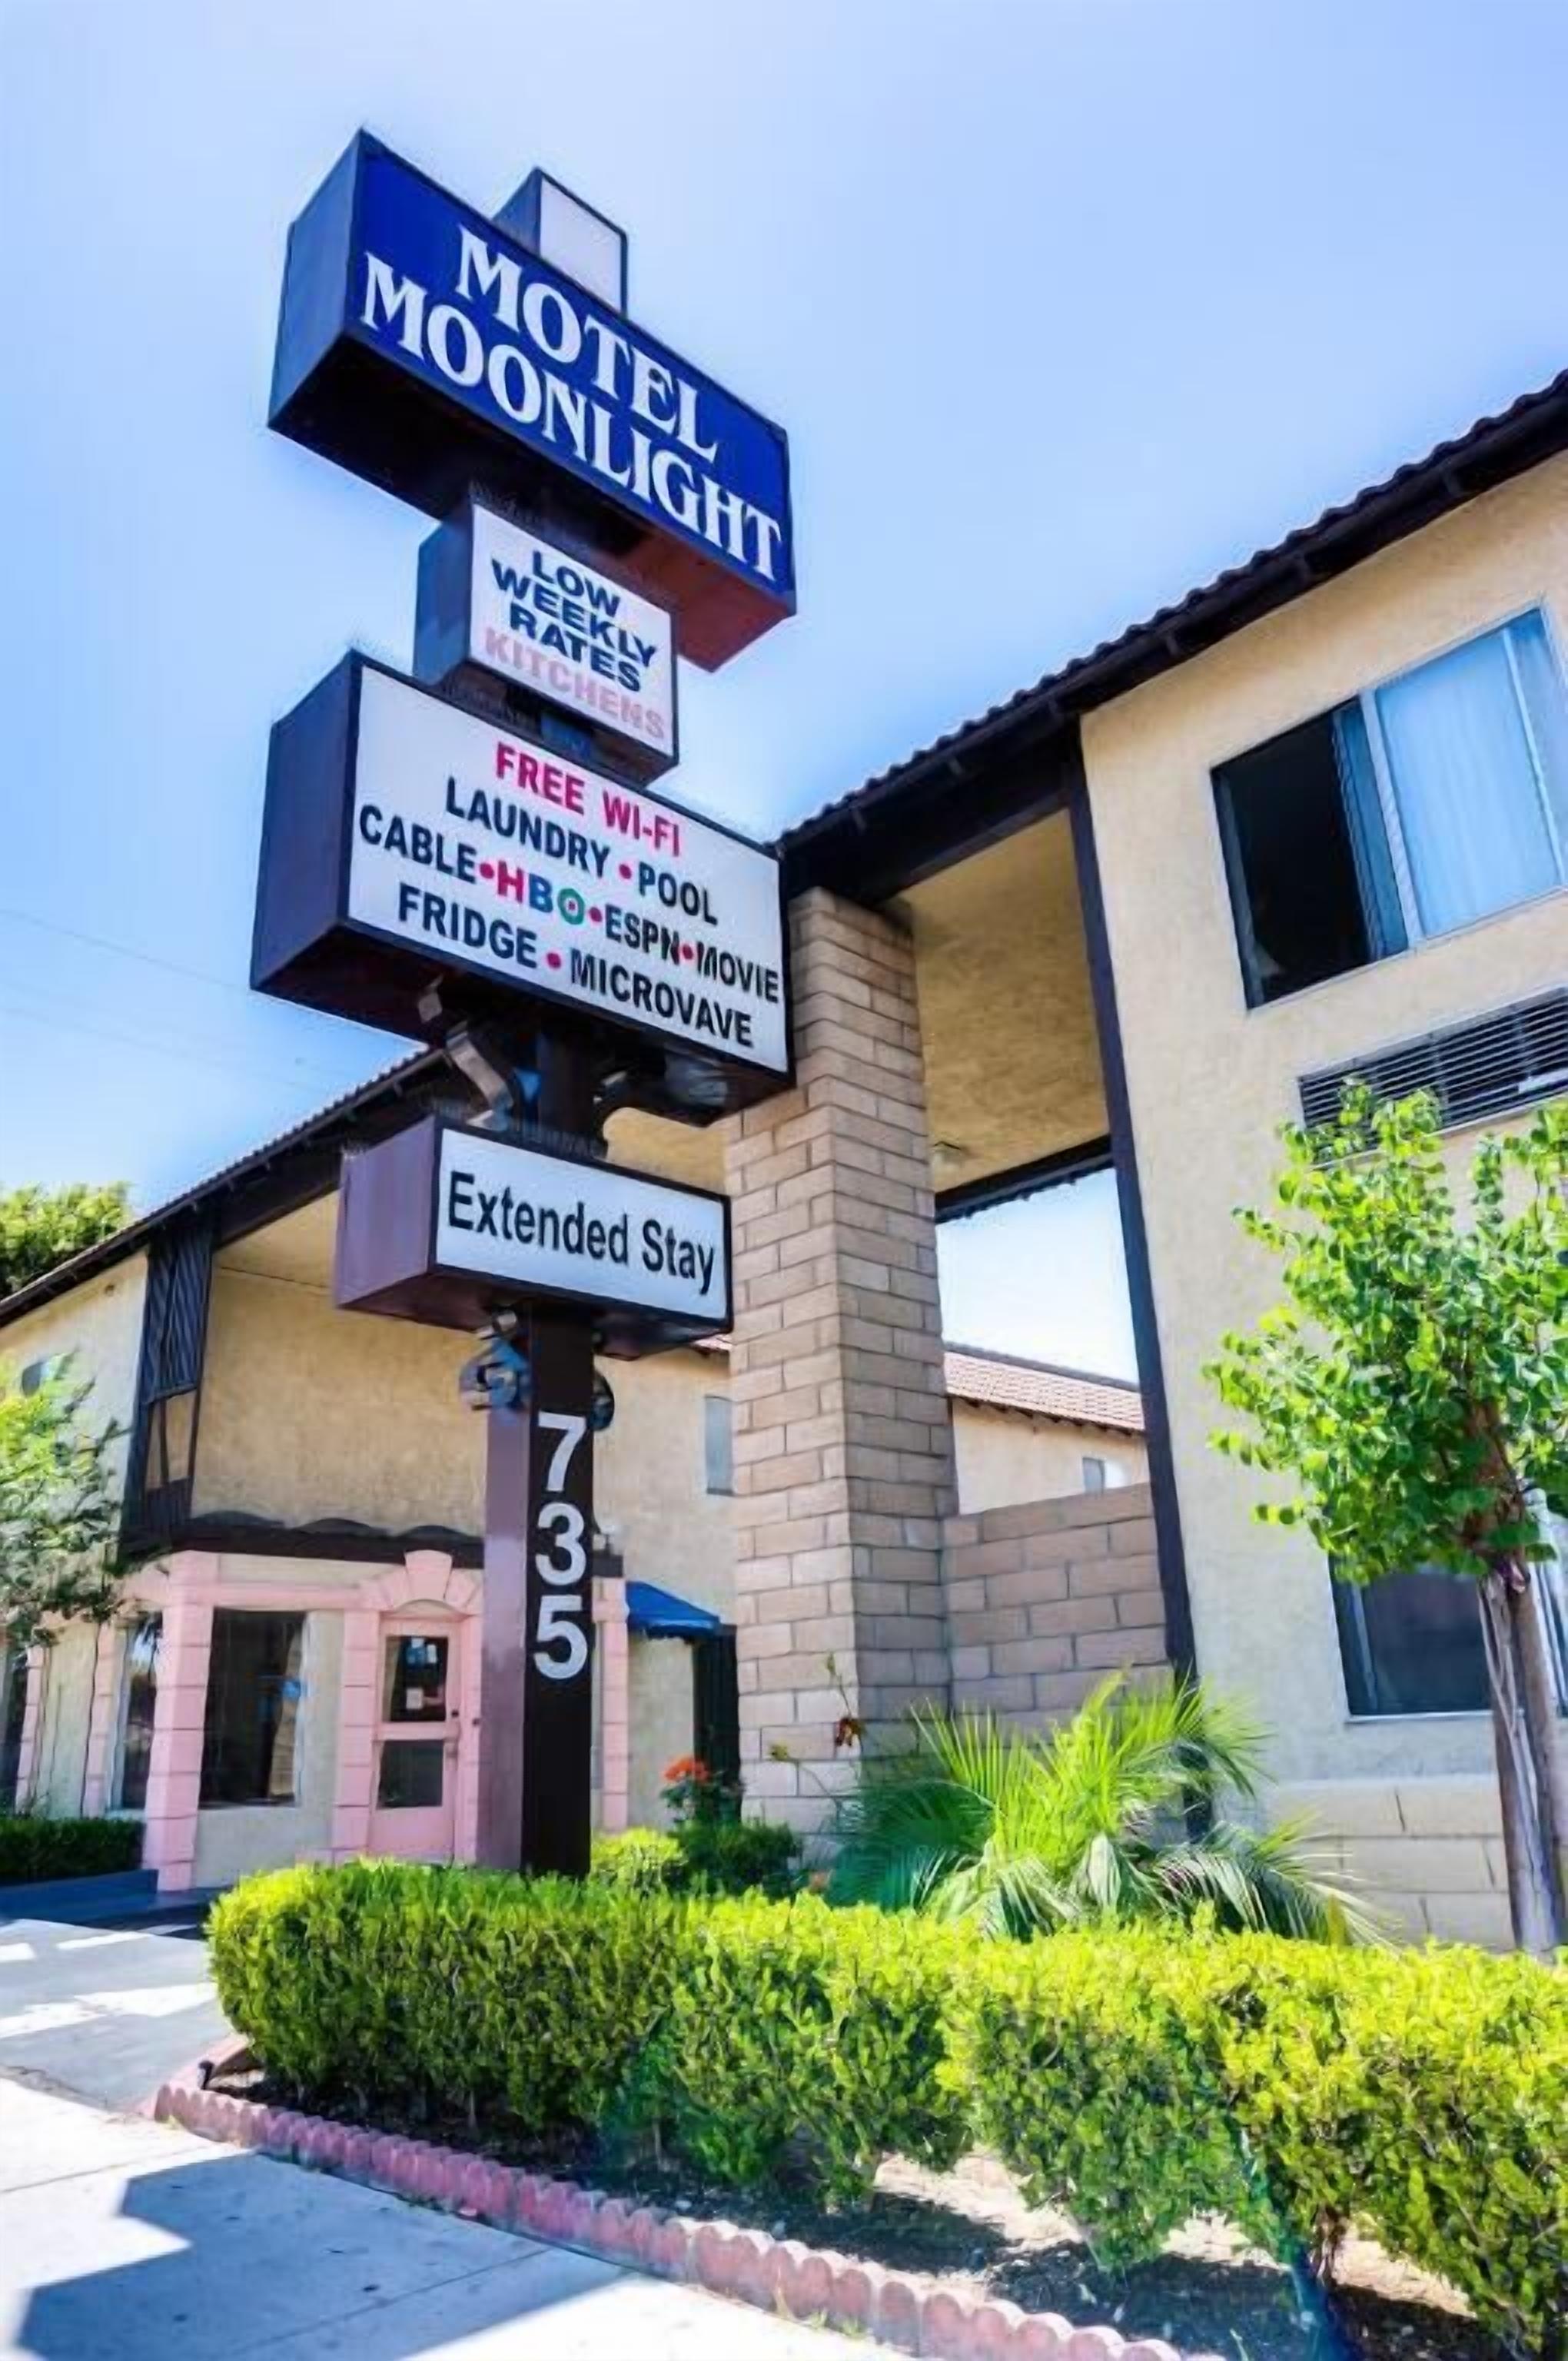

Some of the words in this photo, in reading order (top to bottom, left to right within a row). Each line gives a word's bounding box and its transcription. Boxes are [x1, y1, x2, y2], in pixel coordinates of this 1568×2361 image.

[457, 225, 717, 463] MOTEL
[360, 252, 781, 581] MOONLIGHT
[492, 559, 656, 667] WEEKLY
[533, 551, 620, 616] LOW
[485, 627, 664, 739] KITCHENS
[510, 603, 640, 692] RATES
[446, 777, 610, 879] LAUNDRY
[639, 862, 717, 924] POOL
[496, 742, 585, 815] FREE
[602, 791, 679, 857] WI-FI
[360, 805, 476, 882] CABLE
[496, 861, 585, 924] HBO
[606, 904, 680, 965] ESPN
[696, 941, 779, 1003] MOVIE
[398, 883, 537, 968] FRIDGE
[449, 1171, 628, 1266] Extended
[642, 1220, 715, 1295] Stay
[533, 1411, 588, 1679] 735
